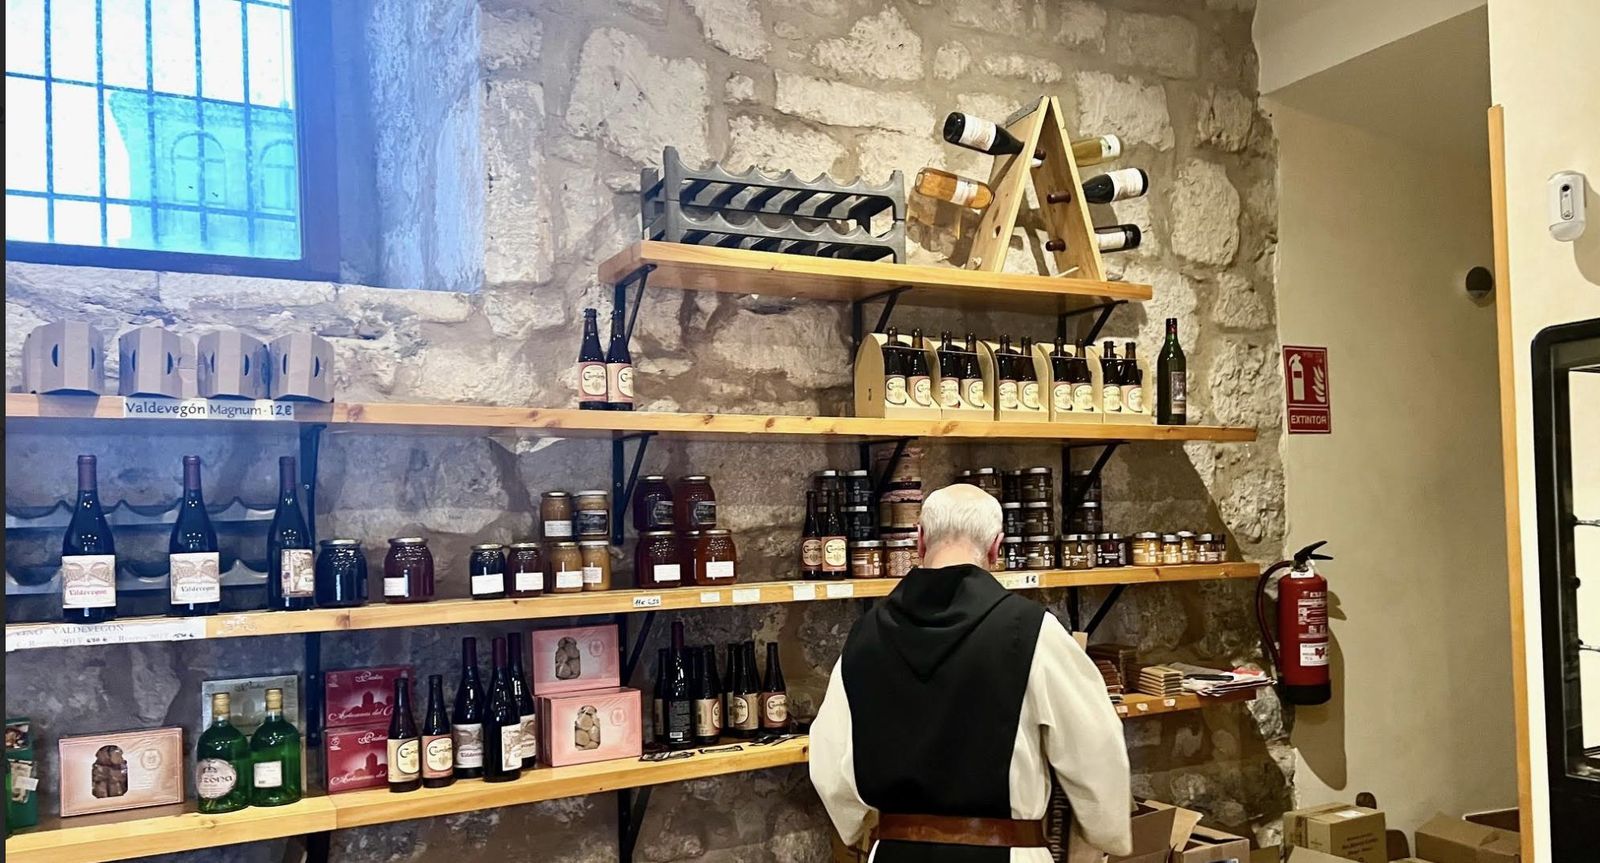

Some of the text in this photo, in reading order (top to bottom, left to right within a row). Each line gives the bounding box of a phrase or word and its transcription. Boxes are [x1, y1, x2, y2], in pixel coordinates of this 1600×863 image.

[125, 402, 206, 417] Valdevegón
[209, 404, 262, 418] Magnum
[1290, 415, 1327, 425] EXTINTOR
